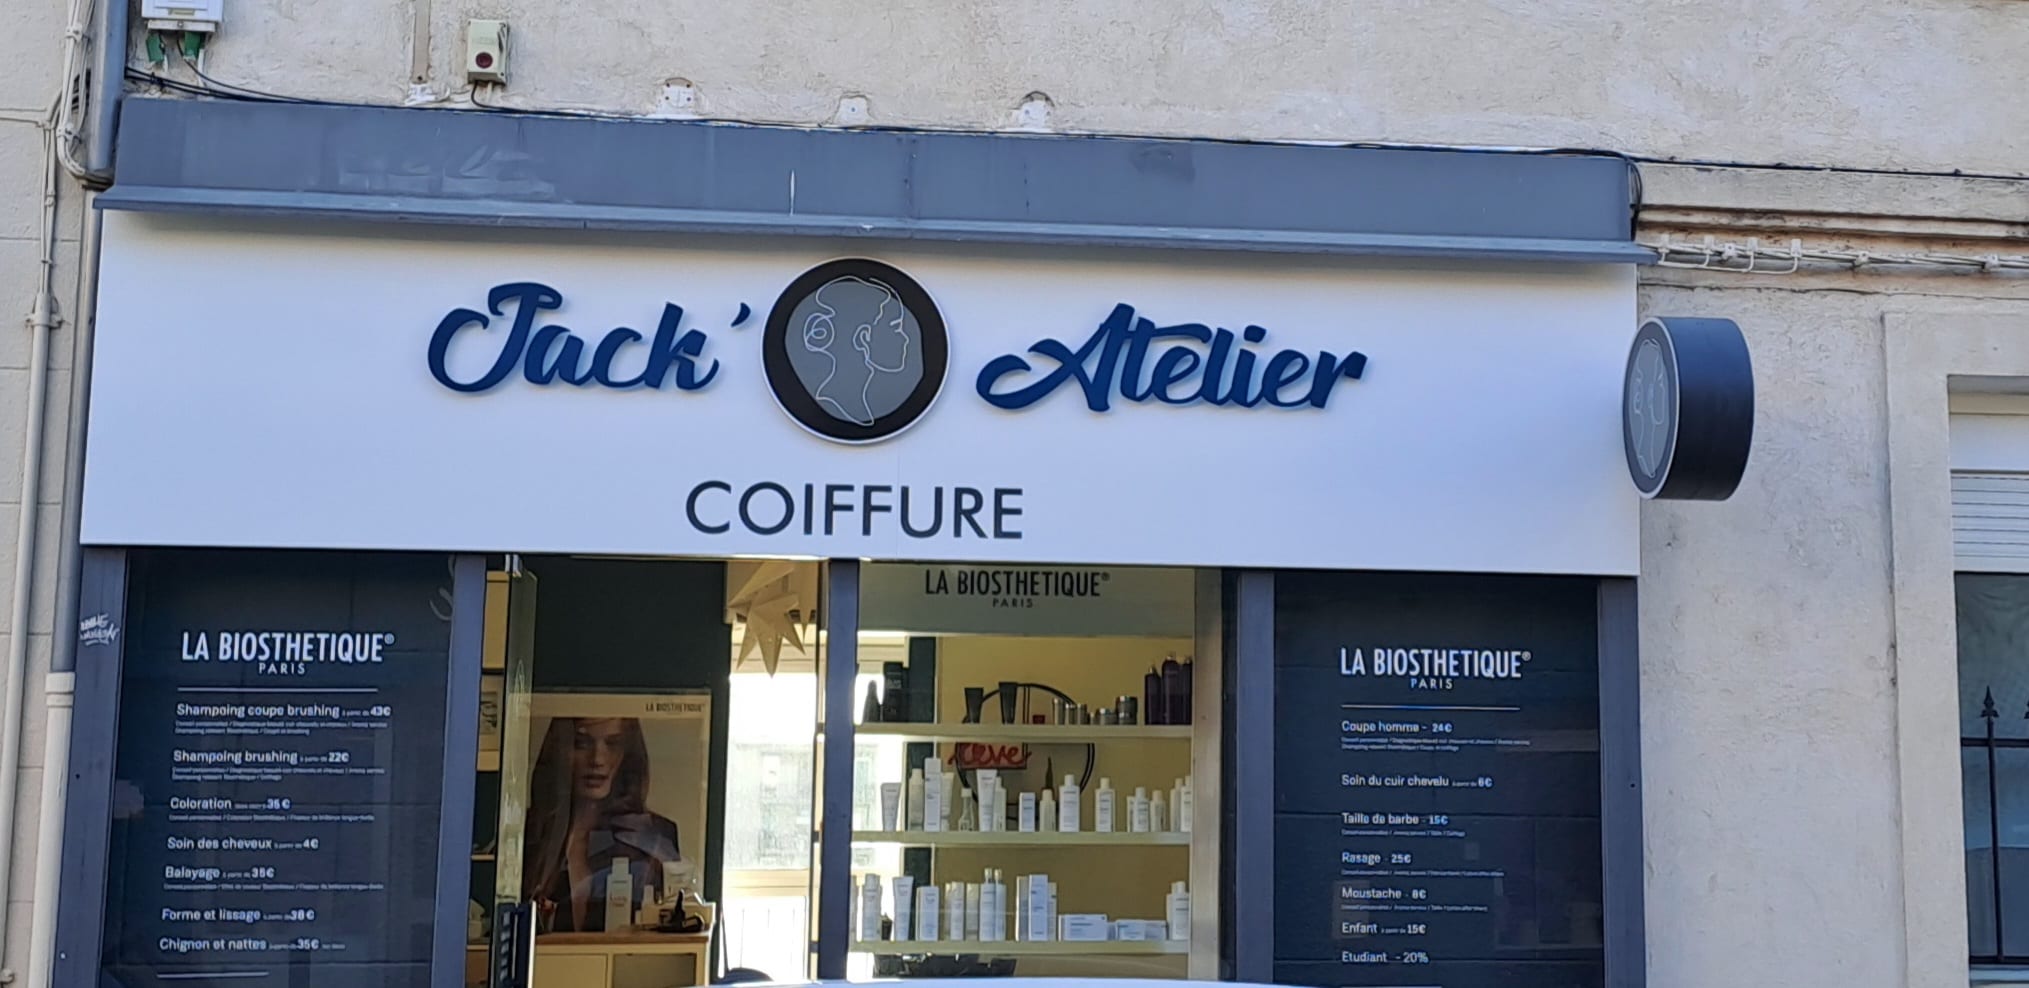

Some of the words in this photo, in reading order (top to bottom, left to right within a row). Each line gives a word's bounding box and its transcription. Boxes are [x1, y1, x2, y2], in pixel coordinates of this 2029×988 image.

[976, 303, 1367, 414] Atelier
[685, 480, 1024, 540] COIFFURE
[925, 569, 949, 595] LA
[992, 598, 1034, 608] PARIS
[181, 631, 210, 661] LA
[1340, 647, 1366, 675] LA
[258, 662, 306, 675] PARIS
[1410, 677, 1453, 689] PARIS
[176, 703, 245, 718] Shampoing
[247, 705, 284, 718] coupe
[287, 703, 340, 718] brushing
[1341, 720, 1376, 733] Coupe
[1378, 721, 1420, 732] homme
[173, 749, 242, 764] Shampoing
[244, 750, 298, 765] brushing
[1341, 774, 1366, 787] Soin
[1368, 774, 1382, 787] du
[1384, 775, 1404, 787] cuir
[1407, 774, 1449, 787] chevelu
[169, 796, 232, 810] Coloration
[1342, 812, 1370, 825] Taille
[1372, 813, 1386, 825] de
[1388, 813, 1420, 825] barbe
[167, 836, 194, 849] Soin
[197, 836, 219, 849] des
[221, 837, 273, 849] cheveux
[1342, 851, 1381, 866] Rasage
[164, 865, 220, 881] Balayage
[1342, 887, 1402, 899] Moustache
[161, 908, 202, 921] Forme
[203, 909, 217, 921] et
[219, 908, 261, 924] lissage
[1342, 922, 1378, 934] Enfant
[1407, 924, 1426, 934] 15€
[159, 937, 211, 952] Chignon
[212, 939, 226, 950] et
[228, 938, 267, 950] nattes
[1342, 951, 1388, 963] Etudiant
